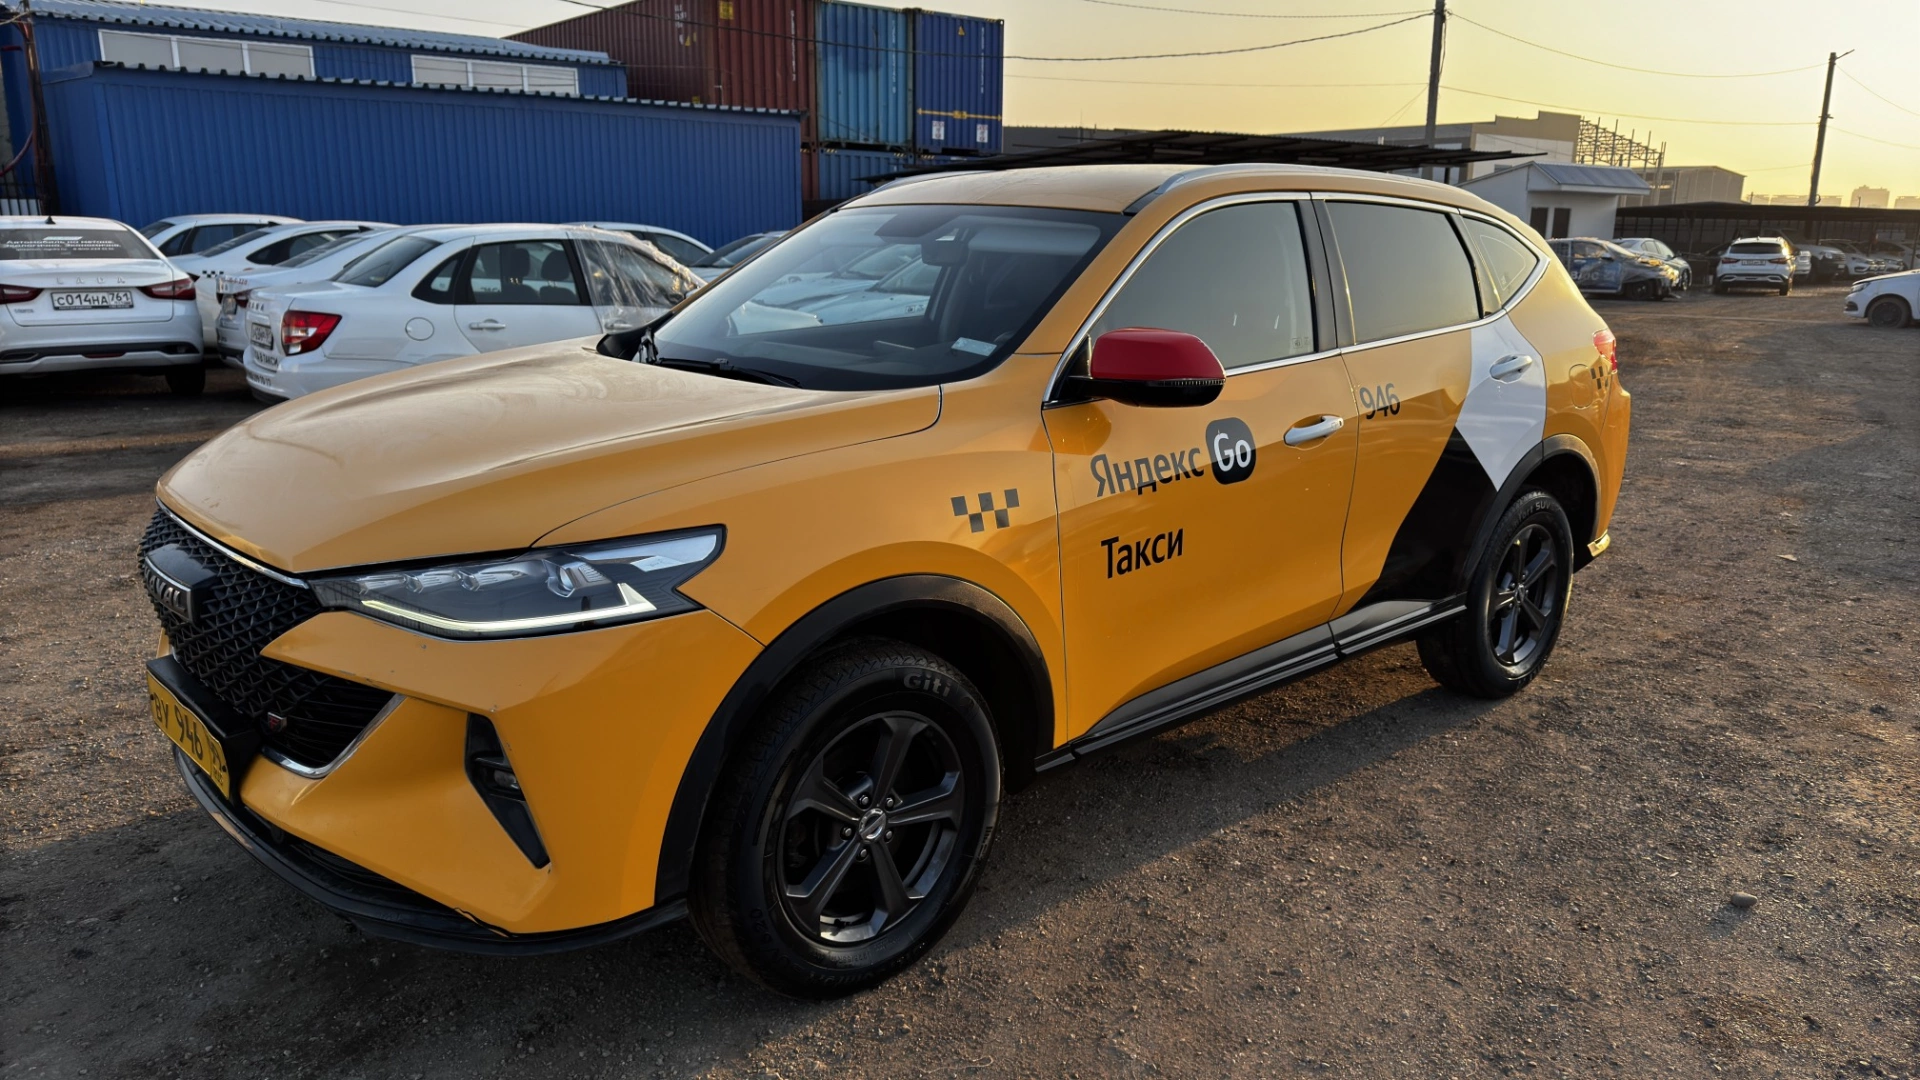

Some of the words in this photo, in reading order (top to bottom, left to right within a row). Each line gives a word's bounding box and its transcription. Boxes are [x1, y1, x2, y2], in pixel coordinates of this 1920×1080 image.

[110, 292, 130, 302] 761
[1358, 383, 1401, 420] 946
[1090, 447, 1205, 498] Яндекс
[1213, 432, 1252, 472] Go
[1100, 528, 1184, 579] Такси
[903, 671, 952, 698] Giti
[174, 704, 204, 761] 946
